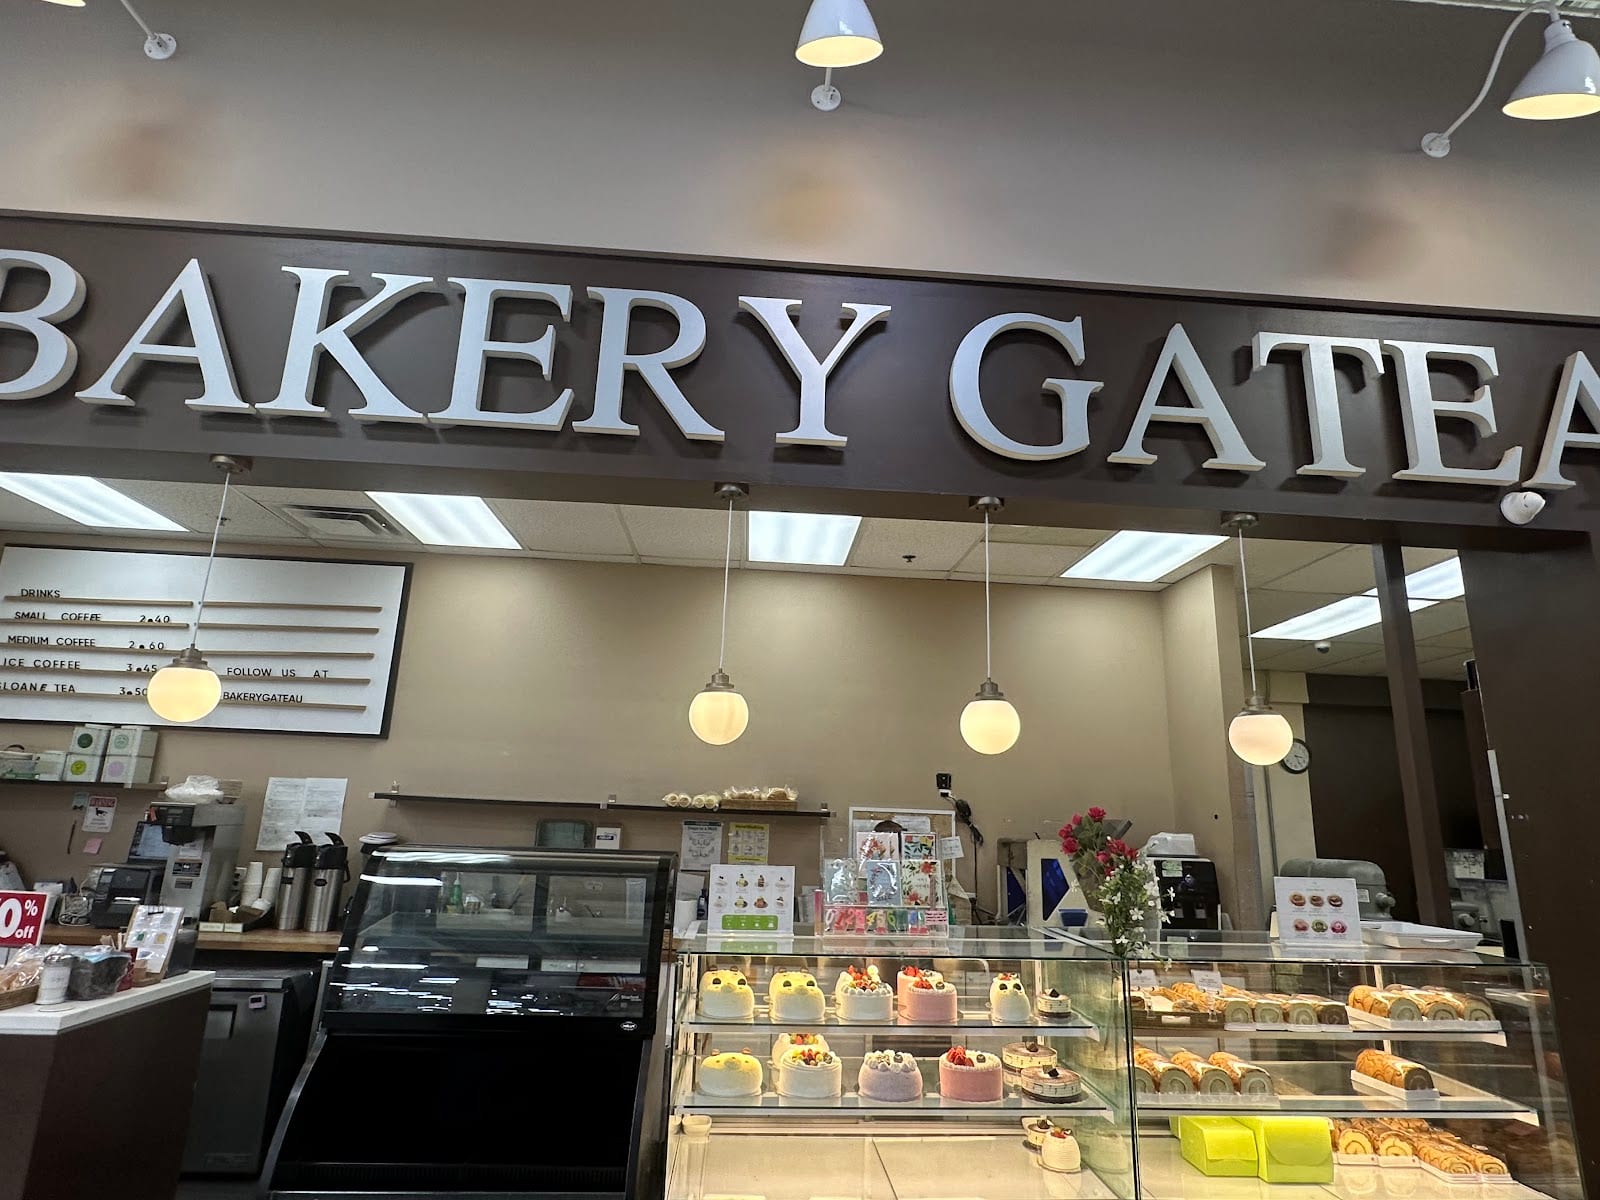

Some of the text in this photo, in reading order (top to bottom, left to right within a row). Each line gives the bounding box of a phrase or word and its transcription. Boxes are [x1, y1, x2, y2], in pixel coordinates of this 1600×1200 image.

[0, 248, 892, 447] BAKERY
[20, 588, 61, 598] DRINKS
[14, 611, 47, 620] SMALL
[61, 612, 102, 621] COFFEE
[7, 635, 49, 645] MEDIUM
[56, 637, 96, 647] COFFEE
[3, 657, 25, 667] ICE
[33, 659, 81, 670] COFFEE
[226, 667, 329, 679] FOLLOW US AT
[0, 681, 48, 691] LOANE
[54, 683, 76, 693] TEA
[222, 691, 303, 704] BAKERYGATEAU
[14, 925, 35, 939] off
